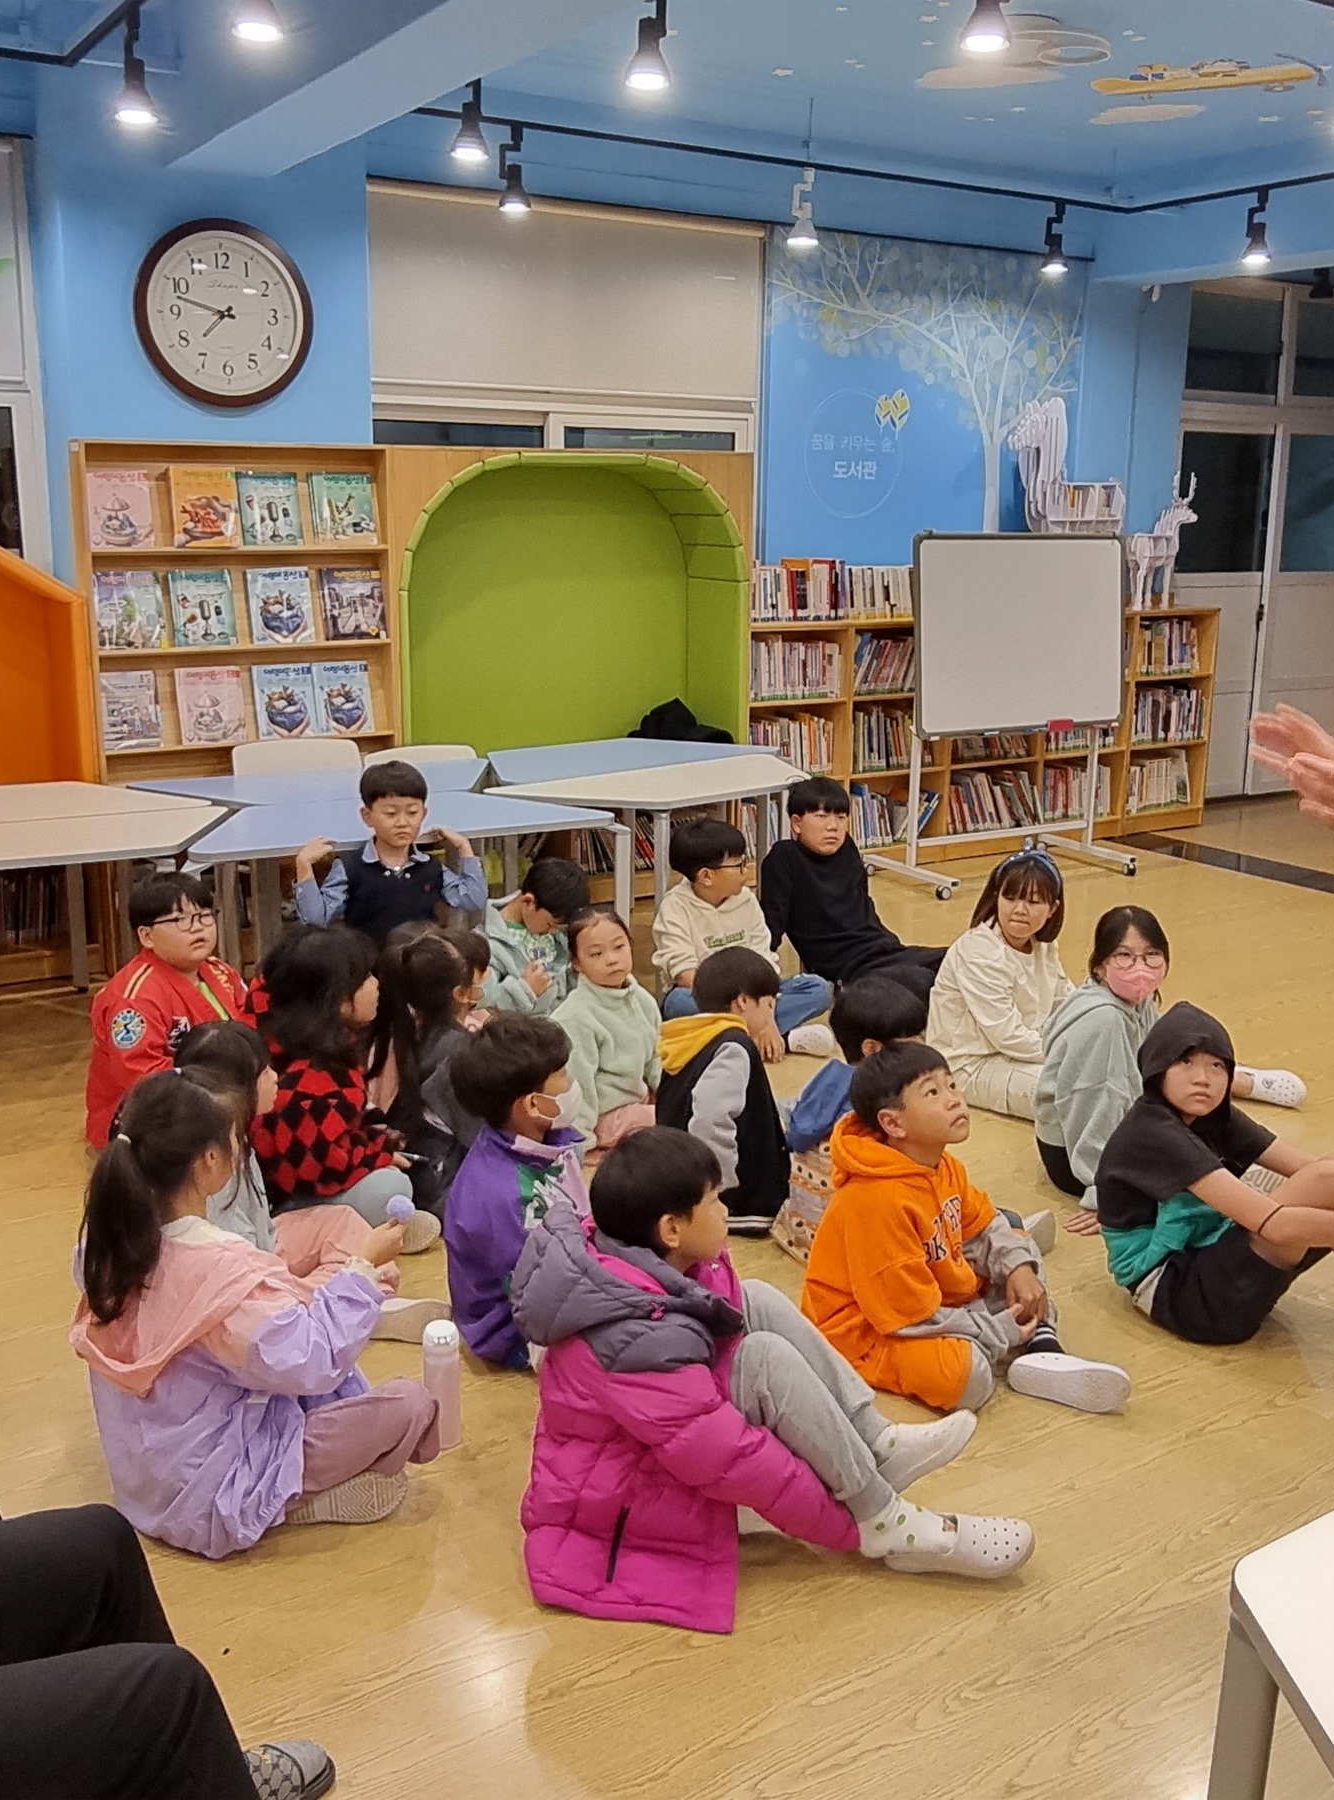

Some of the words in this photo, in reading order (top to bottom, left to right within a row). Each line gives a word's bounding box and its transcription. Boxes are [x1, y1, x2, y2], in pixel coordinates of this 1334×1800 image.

[214, 252, 230, 269] 12
[172, 277, 190, 295] 10
[261, 280, 269, 297] 2
[169, 304, 182, 320] 9
[267, 308, 279, 326] 3
[178, 329, 190, 348] 8
[261, 335, 272, 351] 4
[198, 352, 208, 369] 7
[222, 360, 234, 376] 6
[247, 353, 258, 370] 5
[811, 433, 835, 451] 꿈을
[841, 435, 876, 452] 키우는
[833, 460, 878, 480] 도서관
